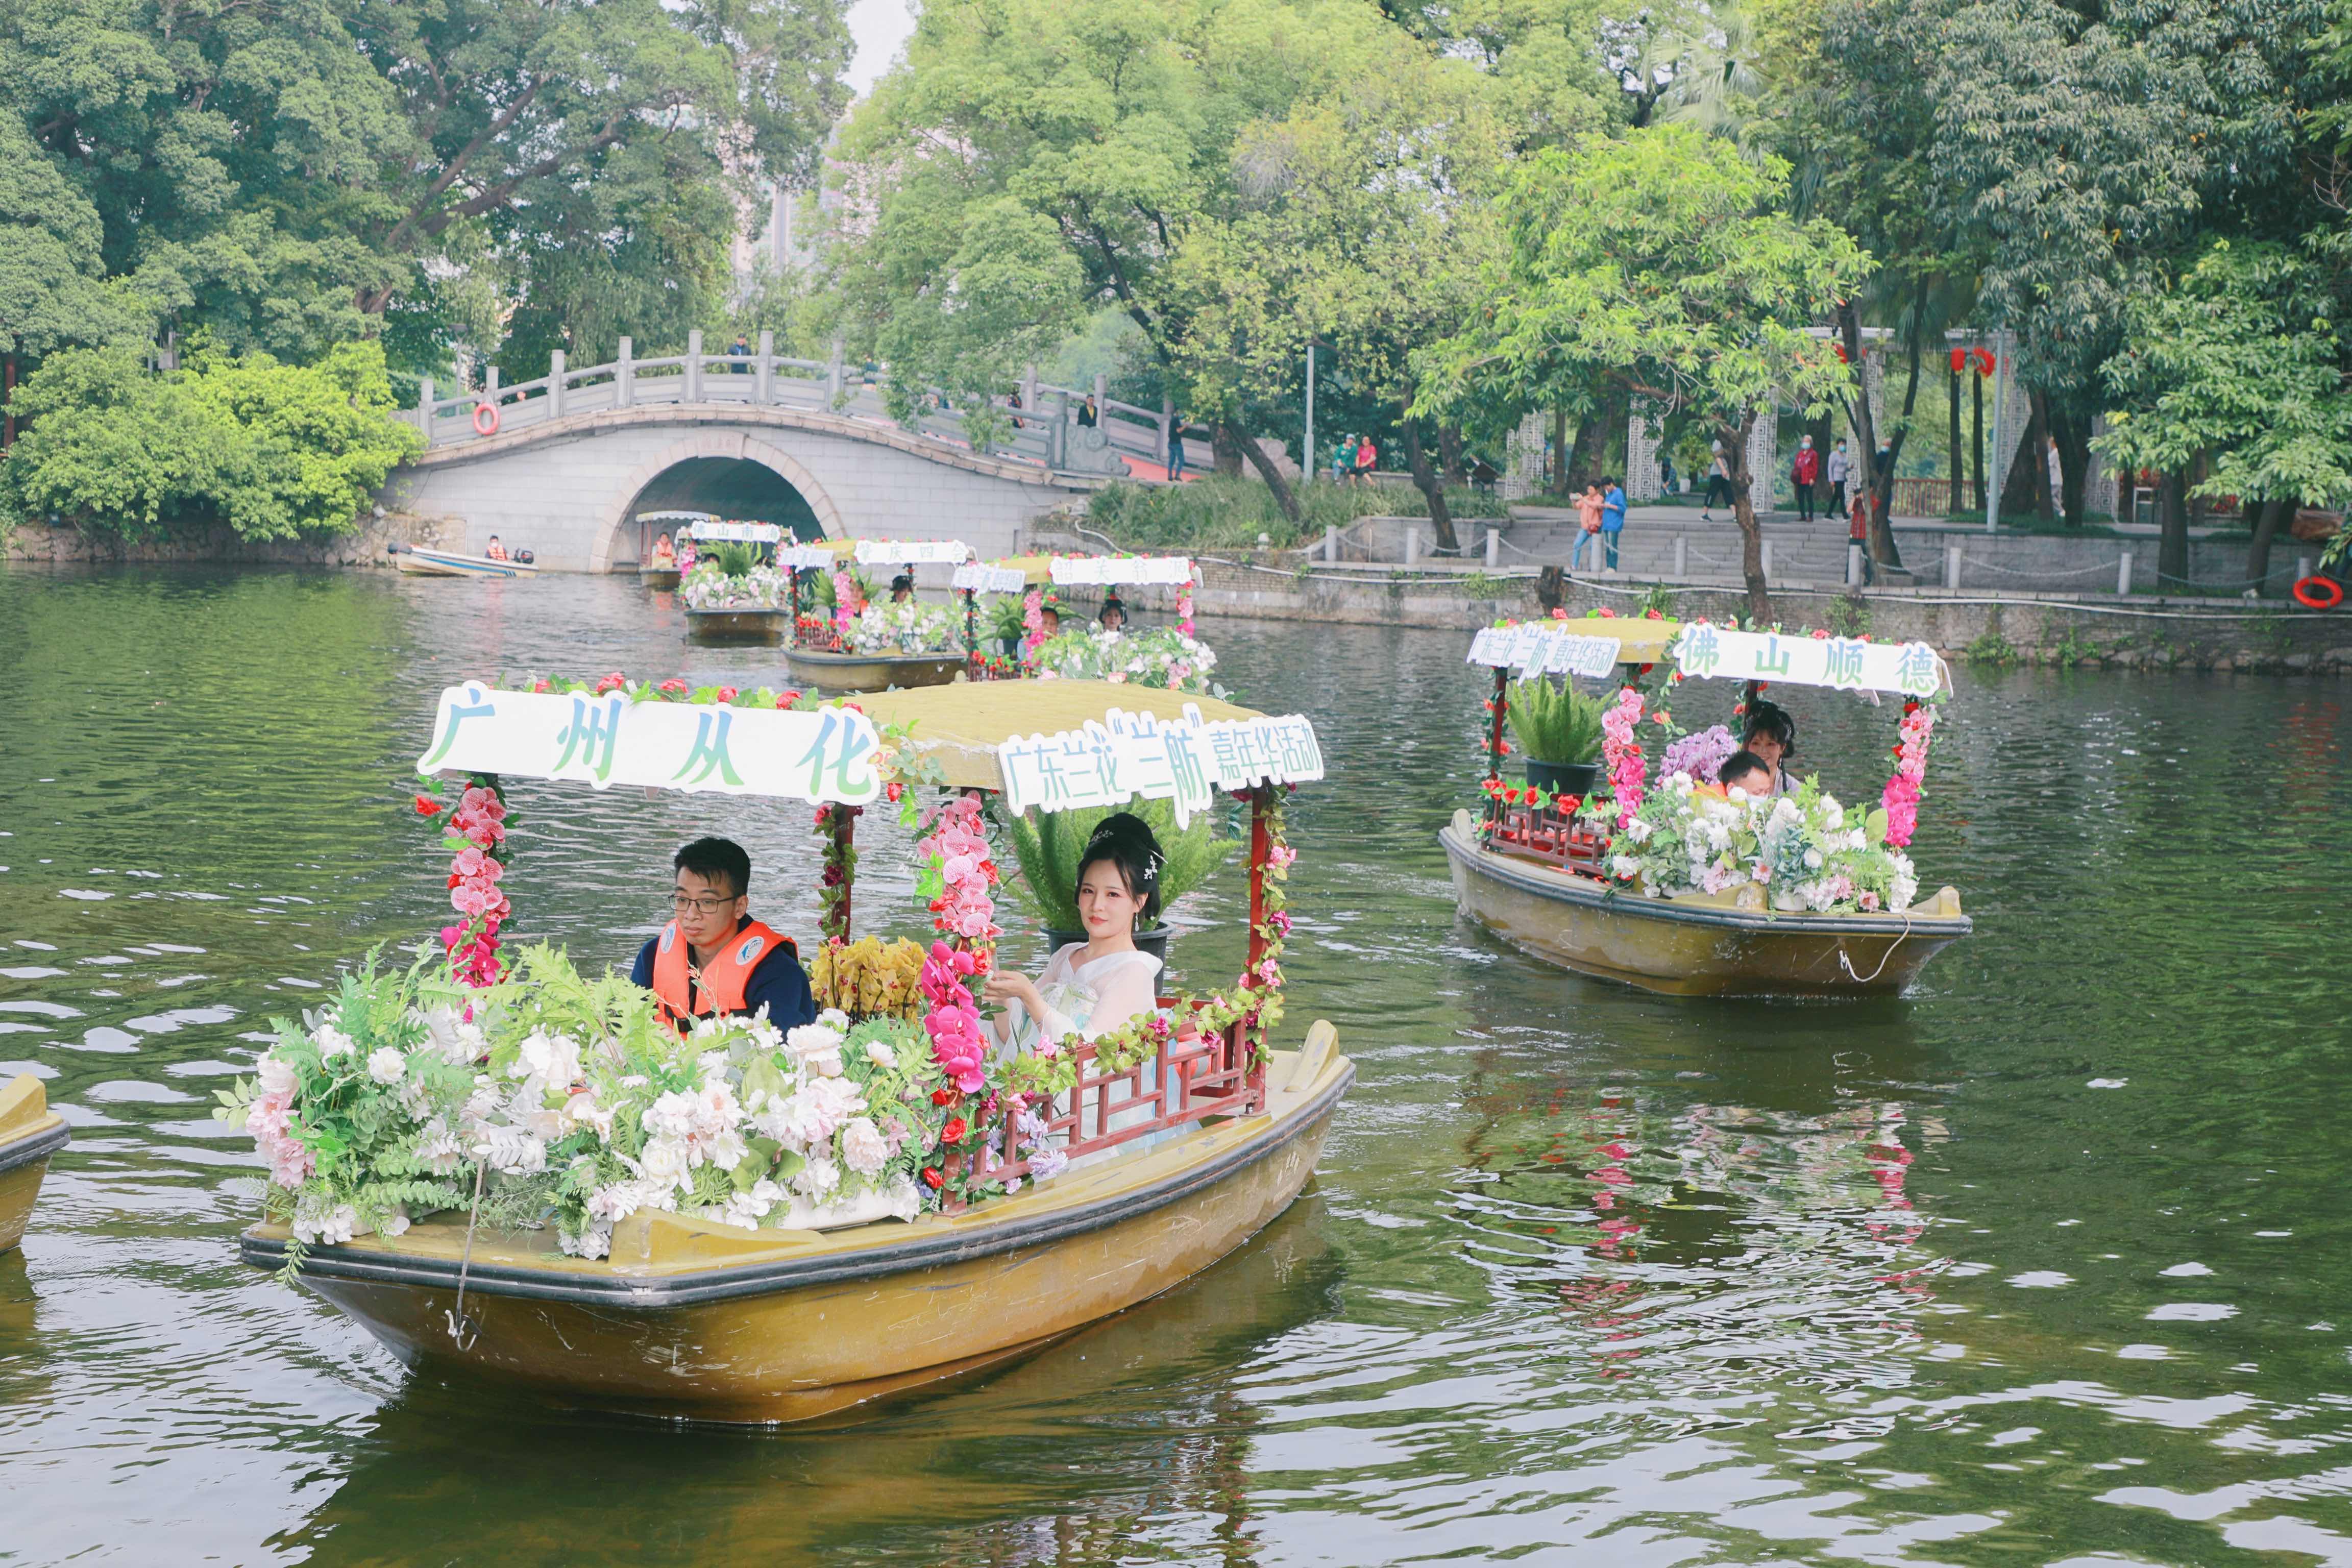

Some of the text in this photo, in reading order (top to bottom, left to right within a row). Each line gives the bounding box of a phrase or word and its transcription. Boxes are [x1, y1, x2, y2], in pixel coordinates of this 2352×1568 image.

[859, 543, 966, 562] 肇庆四会
[1055, 559, 1188, 581] 韶关翁源
[1681, 627, 1935, 692] 佛山顺德
[426, 688, 871, 796] 广州从化
